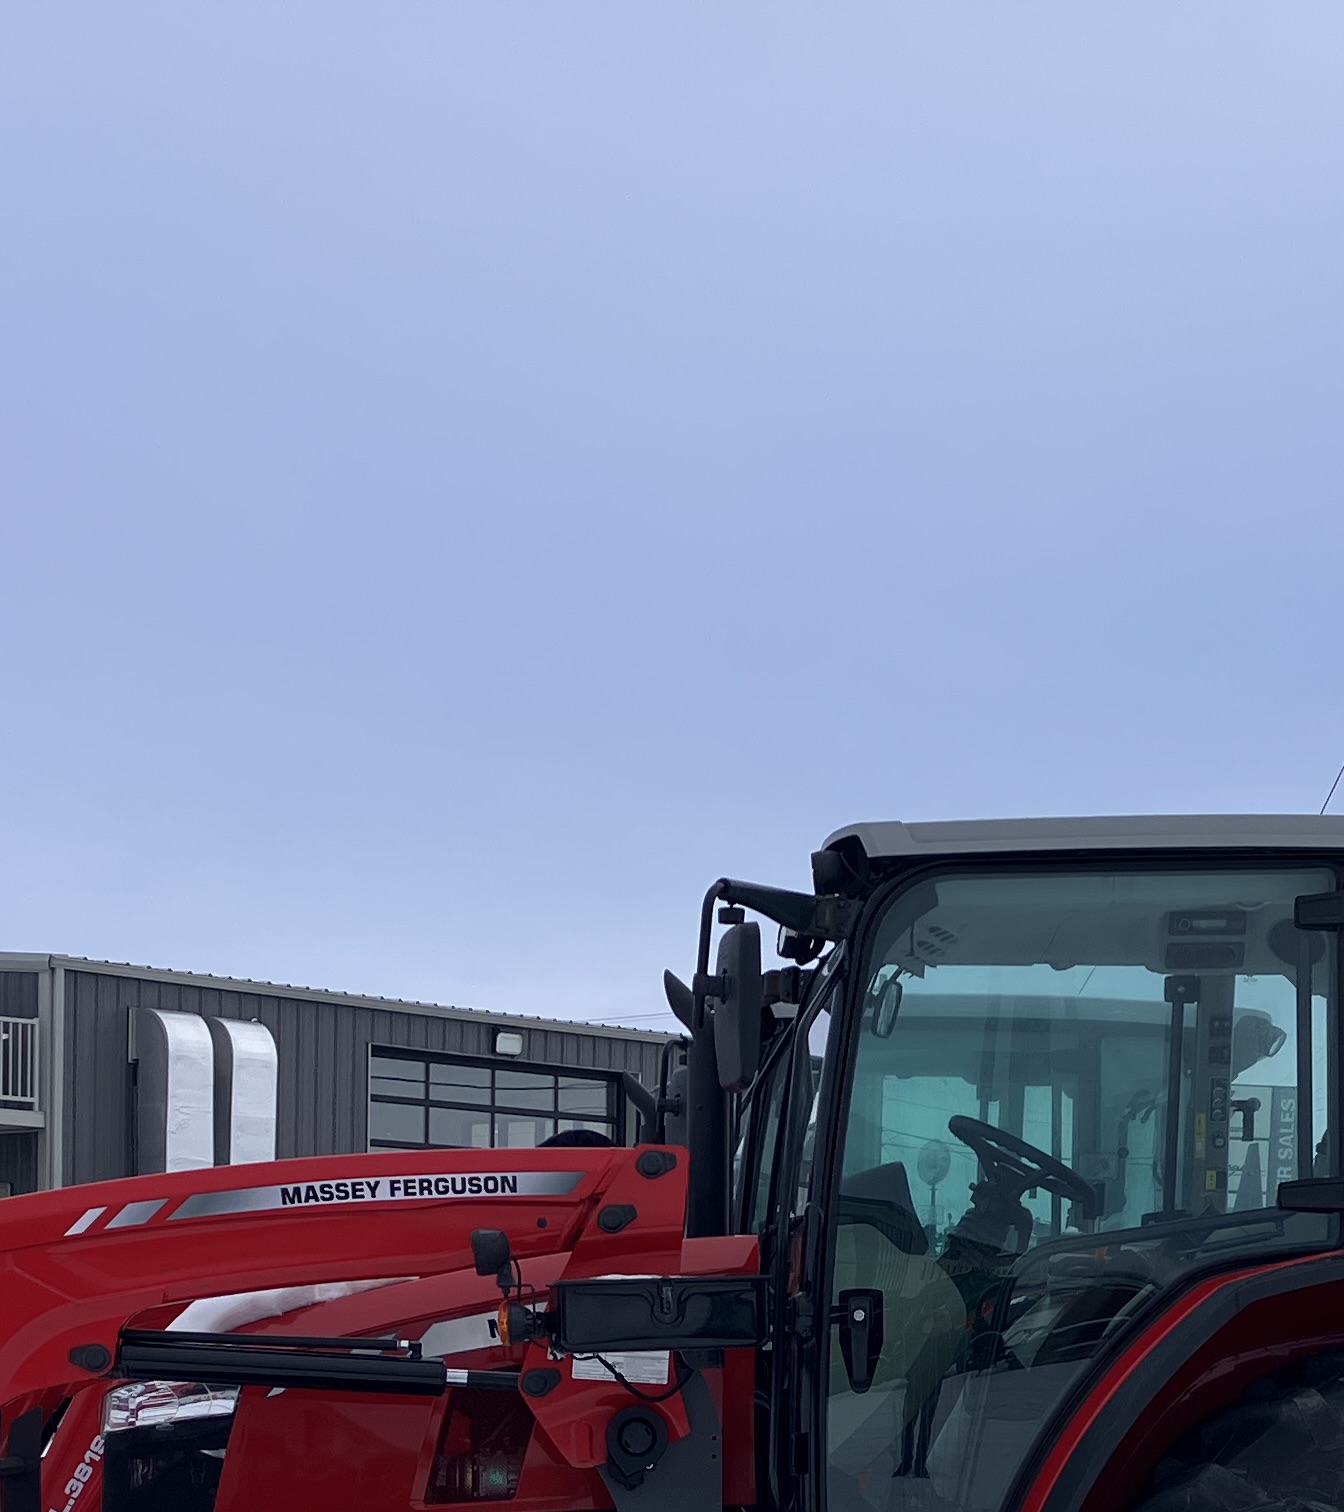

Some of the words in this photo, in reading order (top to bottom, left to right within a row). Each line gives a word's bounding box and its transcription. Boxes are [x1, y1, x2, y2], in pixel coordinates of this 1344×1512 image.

[1278, 1098, 1296, 1160] SALES
[280, 1180, 380, 1206] MASSEY
[389, 1175, 518, 1198] FERGUSON
